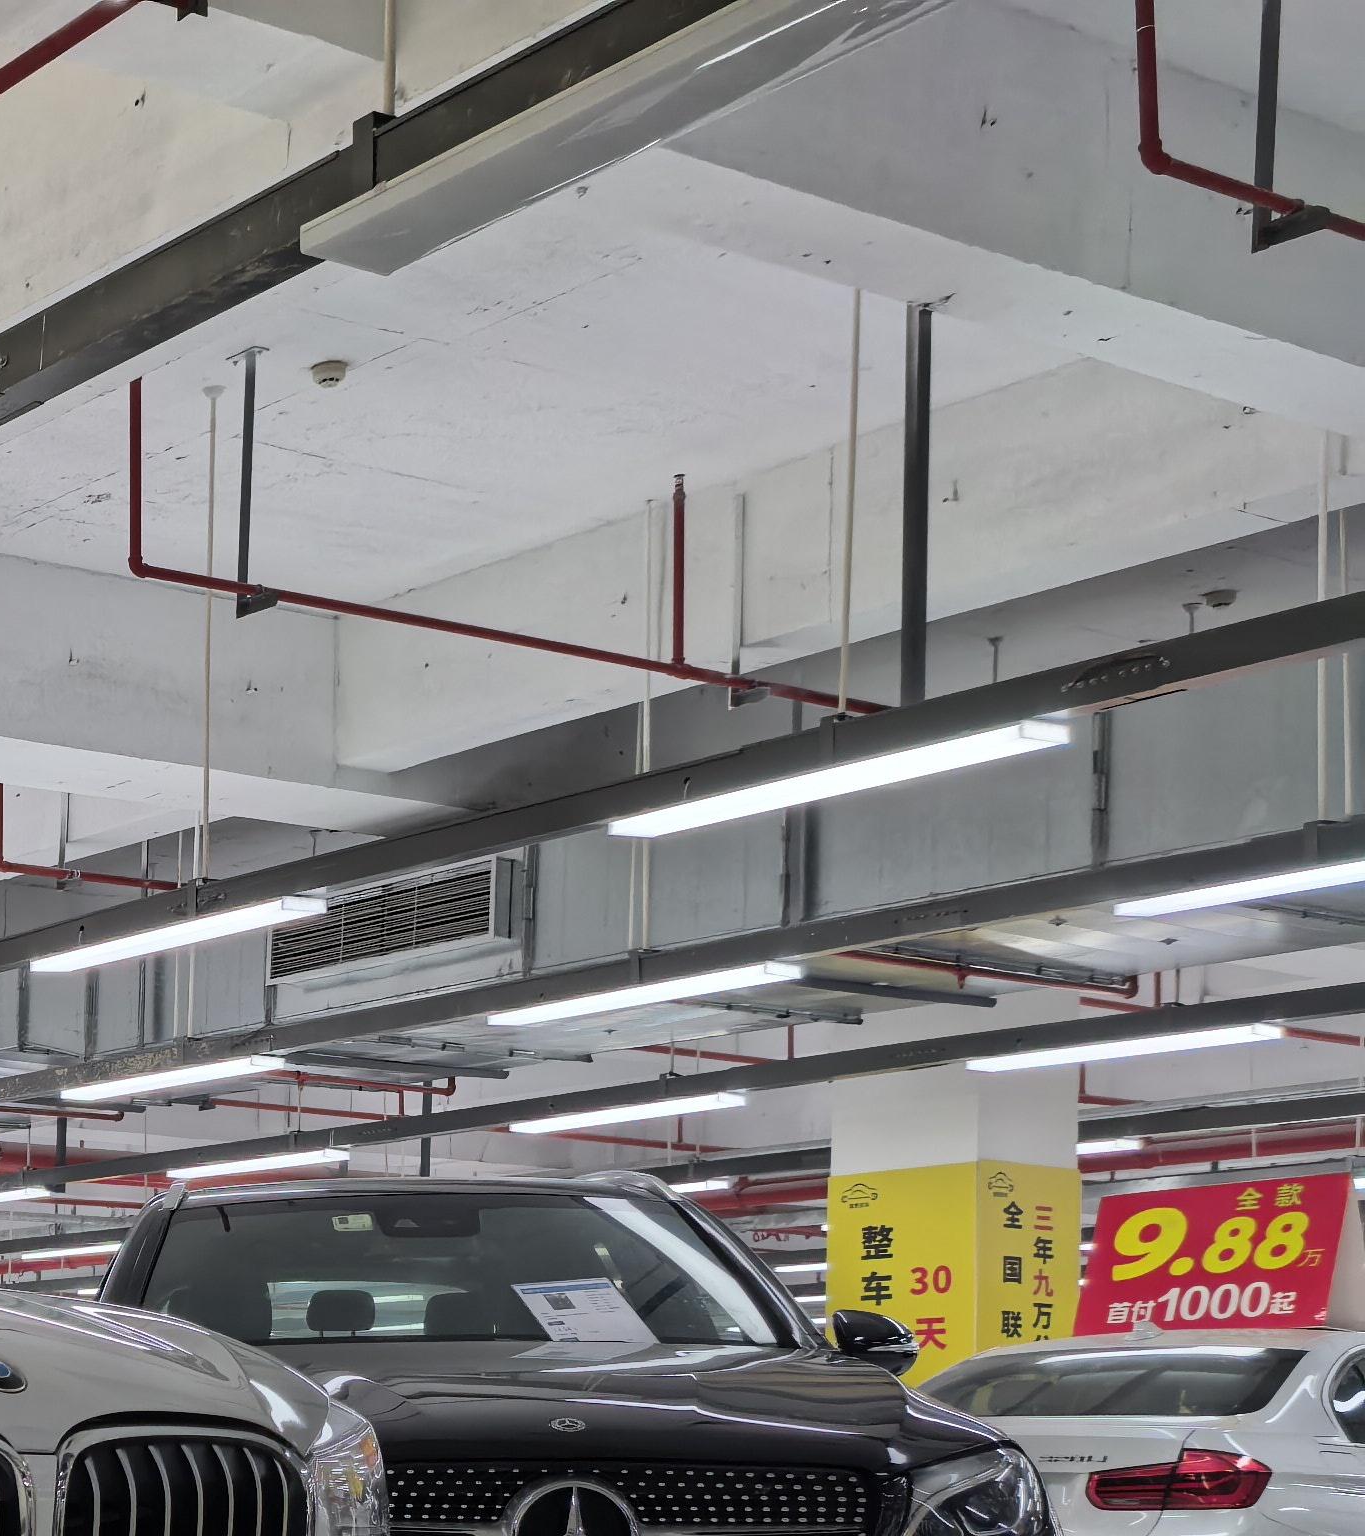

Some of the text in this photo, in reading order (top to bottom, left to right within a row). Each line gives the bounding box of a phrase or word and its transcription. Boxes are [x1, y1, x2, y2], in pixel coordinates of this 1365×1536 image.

[1235, 1183, 1305, 1211] 全款
[860, 1224, 894, 1306] 整车
[1001, 1201, 1024, 1339] 全国联
[1032, 1205, 1055, 1341] 三年九万
[1107, 1281, 1297, 1324] 首付1000起
